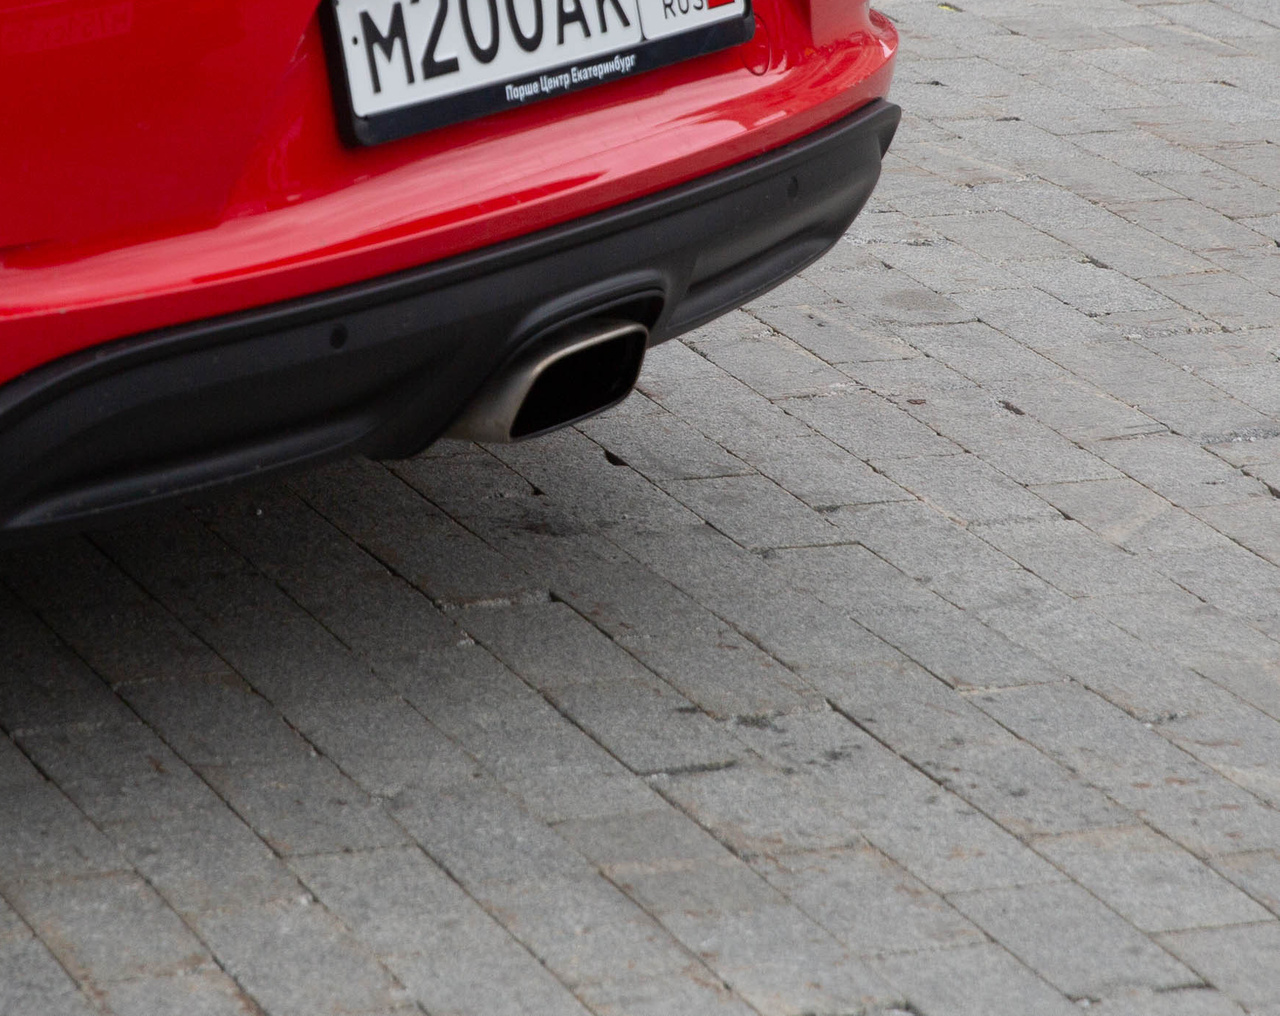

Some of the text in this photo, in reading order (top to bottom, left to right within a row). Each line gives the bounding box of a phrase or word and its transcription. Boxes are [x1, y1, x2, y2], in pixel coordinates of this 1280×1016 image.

[505, 54, 636, 102] Порше Центр Екатеринбург
